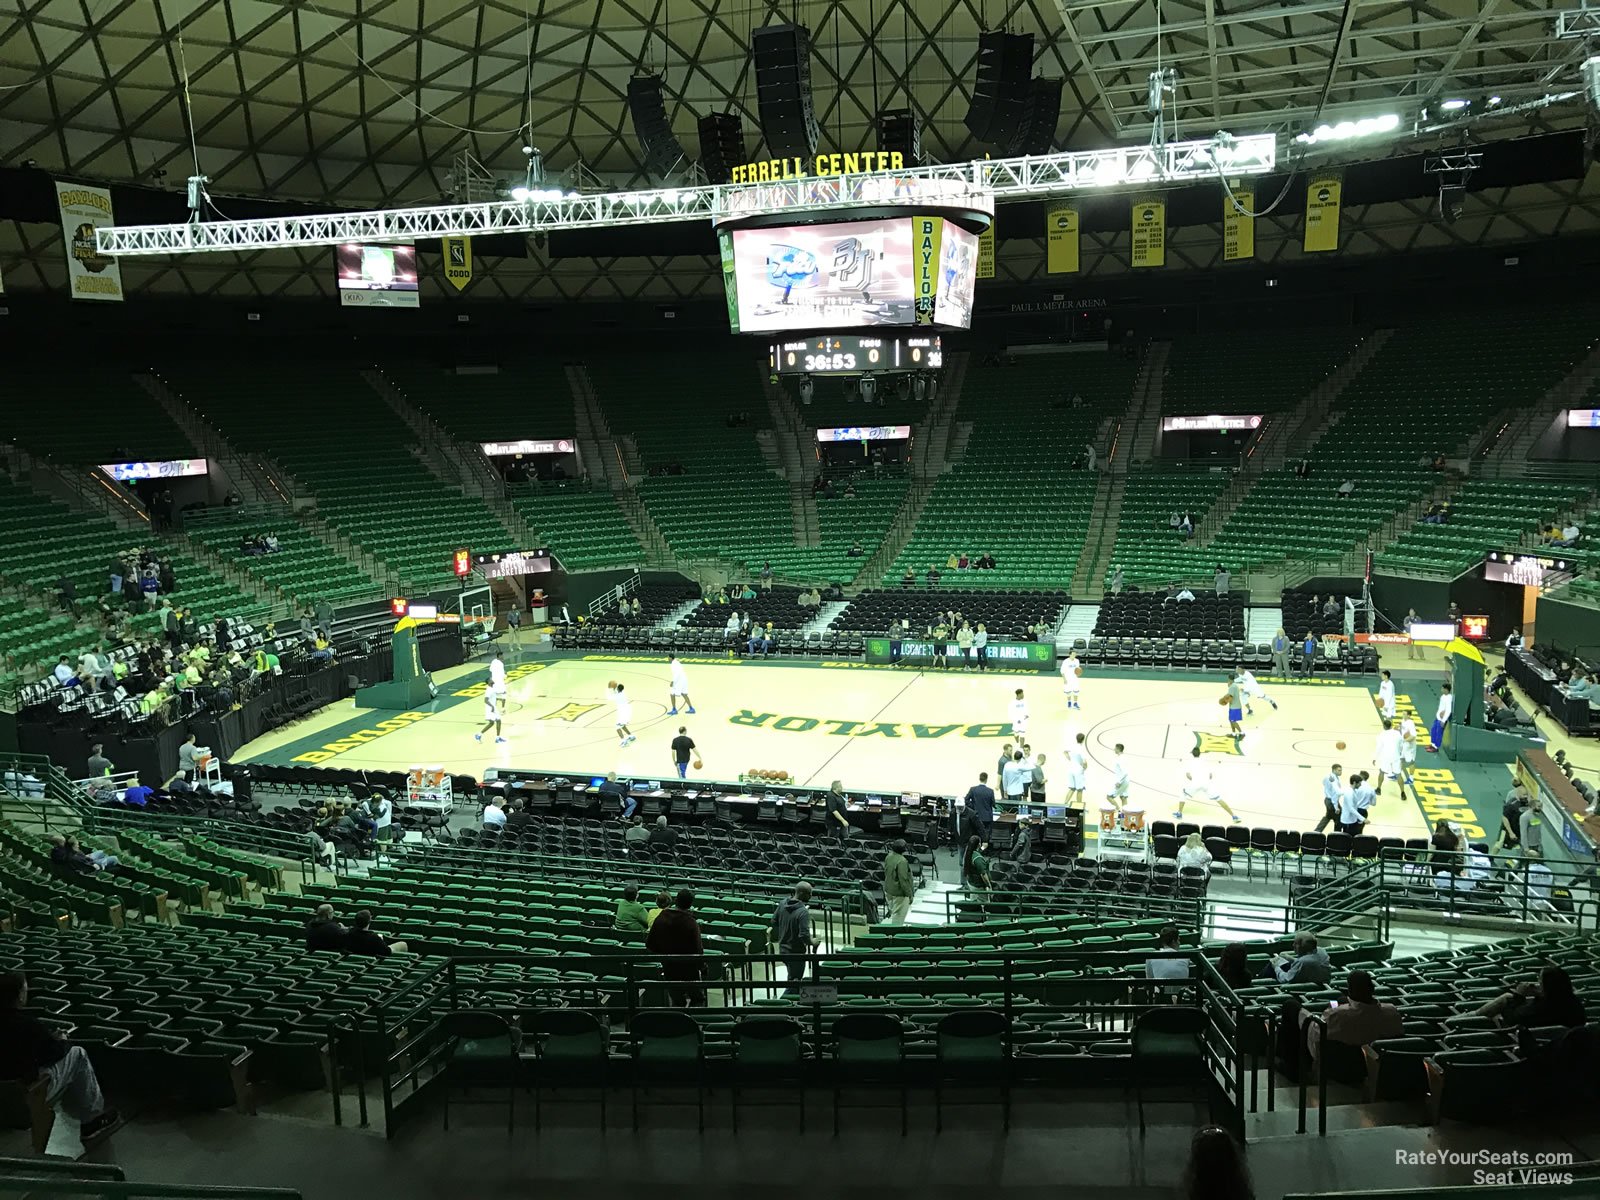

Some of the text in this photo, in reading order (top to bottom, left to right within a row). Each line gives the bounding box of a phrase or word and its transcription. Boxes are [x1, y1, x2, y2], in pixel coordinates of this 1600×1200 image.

[732, 151, 904, 183] FERRELL CENTER
[60, 190, 111, 215] BAYLOR
[922, 220, 933, 311] BAYLOR
[448, 269, 470, 278] 2000
[1011, 303, 1033, 312] PAUL
[1043, 301, 1074, 311] MEYER
[1075, 298, 1107, 308] ARENA
[787, 352, 796, 366] 0
[805, 353, 856, 370] 36:53
[868, 349, 879, 363] 0
[912, 348, 921, 362] 0
[492, 566, 535, 578] BASKETBALL
[1000, 646, 1028, 659] ARENA
[729, 709, 1017, 739] BAYLOR
[289, 711, 434, 764] BAYLOR
